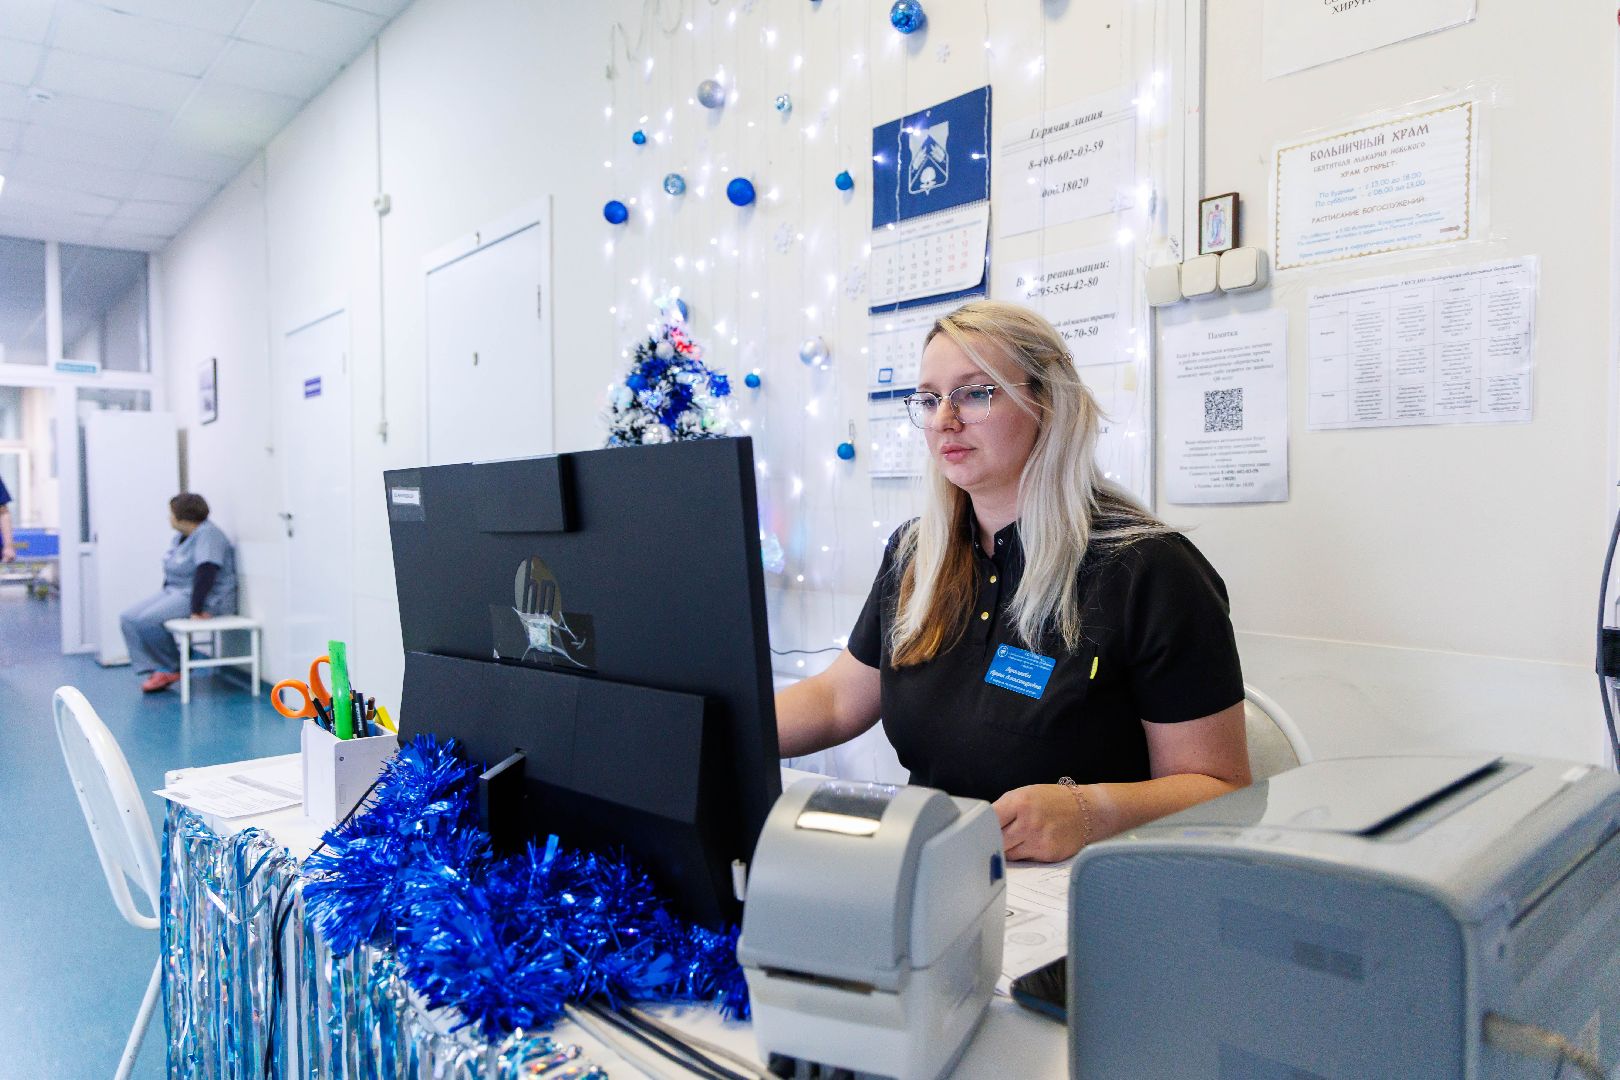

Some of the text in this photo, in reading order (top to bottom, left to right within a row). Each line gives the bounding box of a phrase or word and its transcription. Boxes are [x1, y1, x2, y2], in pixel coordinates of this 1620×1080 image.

[1072, 110, 1103, 127] линия
[1310, 124, 1429, 162] БОЛЬНИЧНЫЙ ХРАМ
[1340, 168, 1361, 178] ХРАМ
[1311, 209, 1360, 224] РАСПИСАНИЕ
[1047, 260, 1110, 283] реанимации:
[1208, 329, 1239, 340] Памятка
